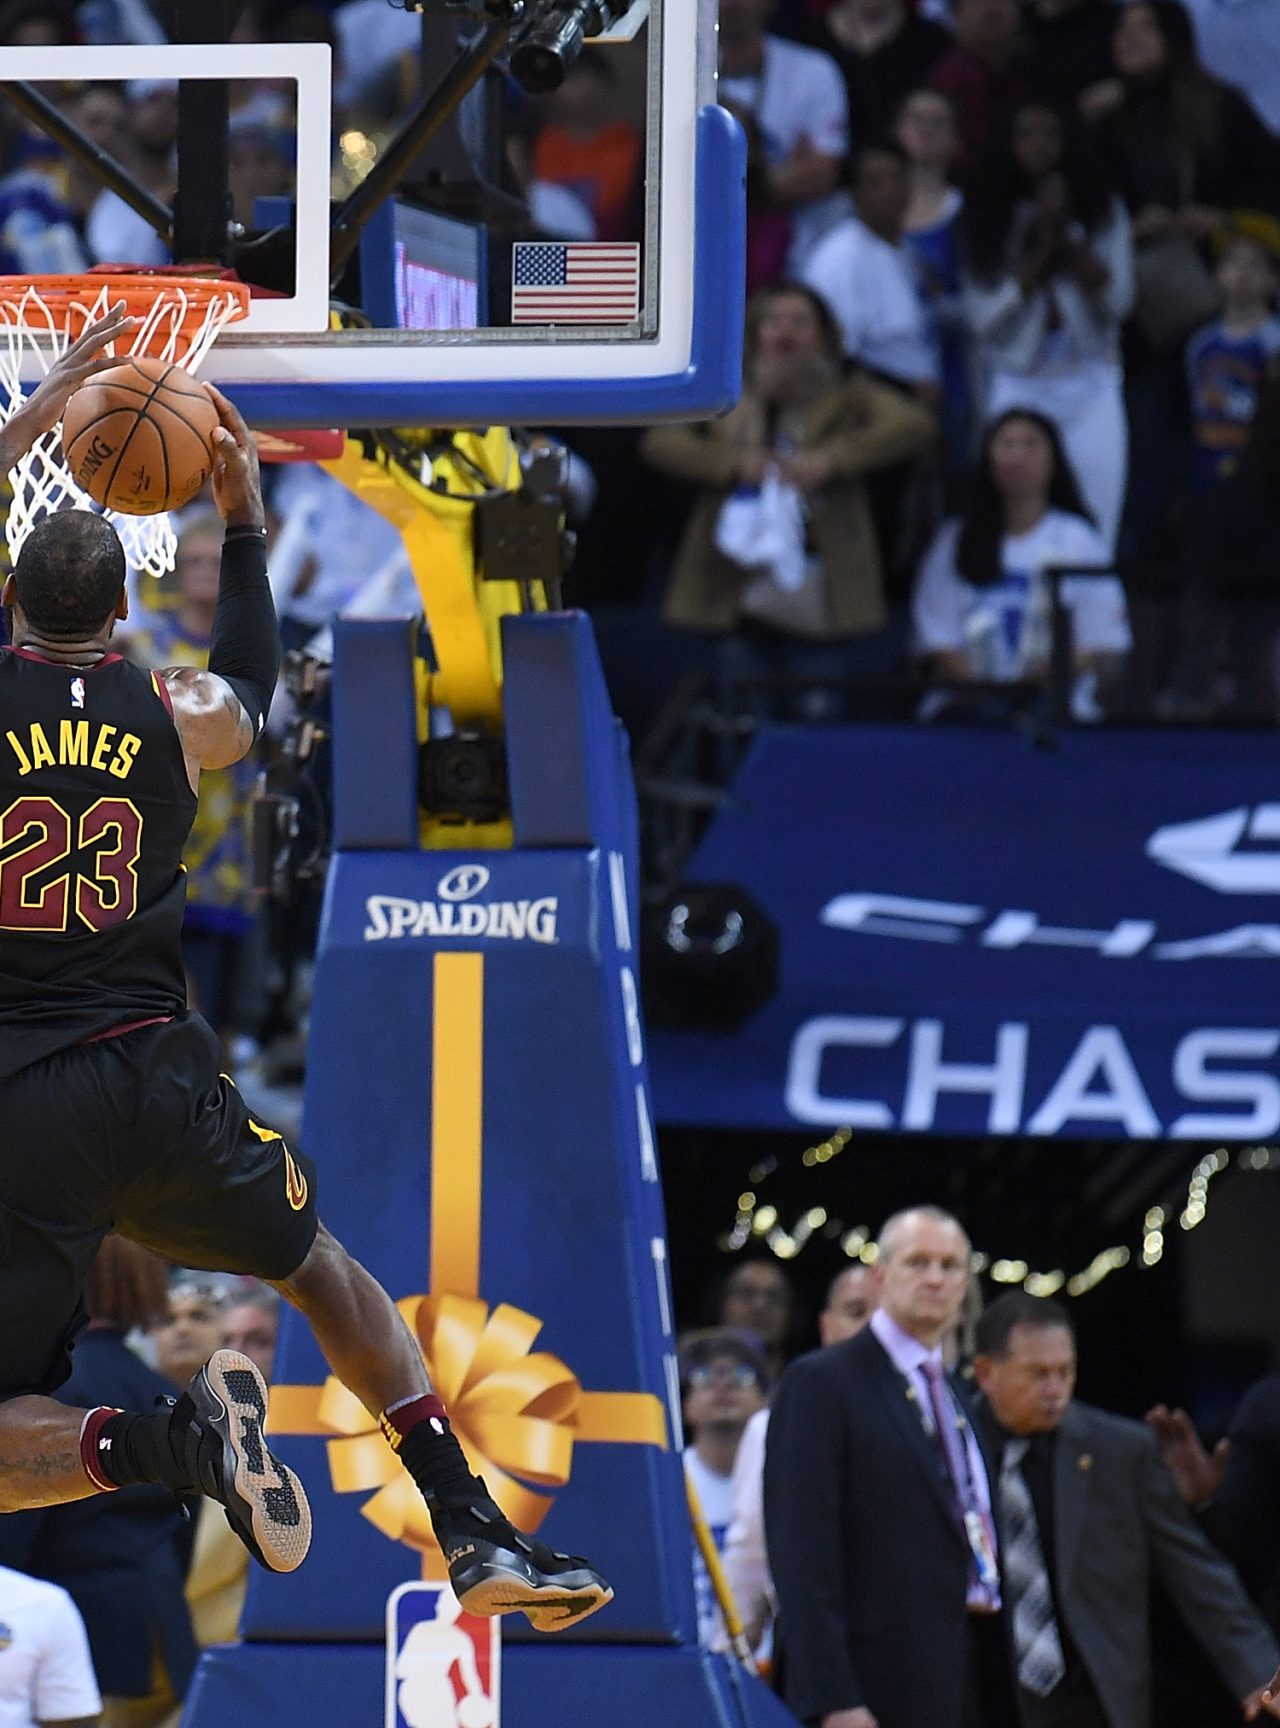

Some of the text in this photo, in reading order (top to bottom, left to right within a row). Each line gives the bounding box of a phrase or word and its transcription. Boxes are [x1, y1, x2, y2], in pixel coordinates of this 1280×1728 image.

[6, 719, 142, 779] JAMES
[364, 895, 558, 944] SPALDING
[784, 1014, 1280, 1140] CHAS
